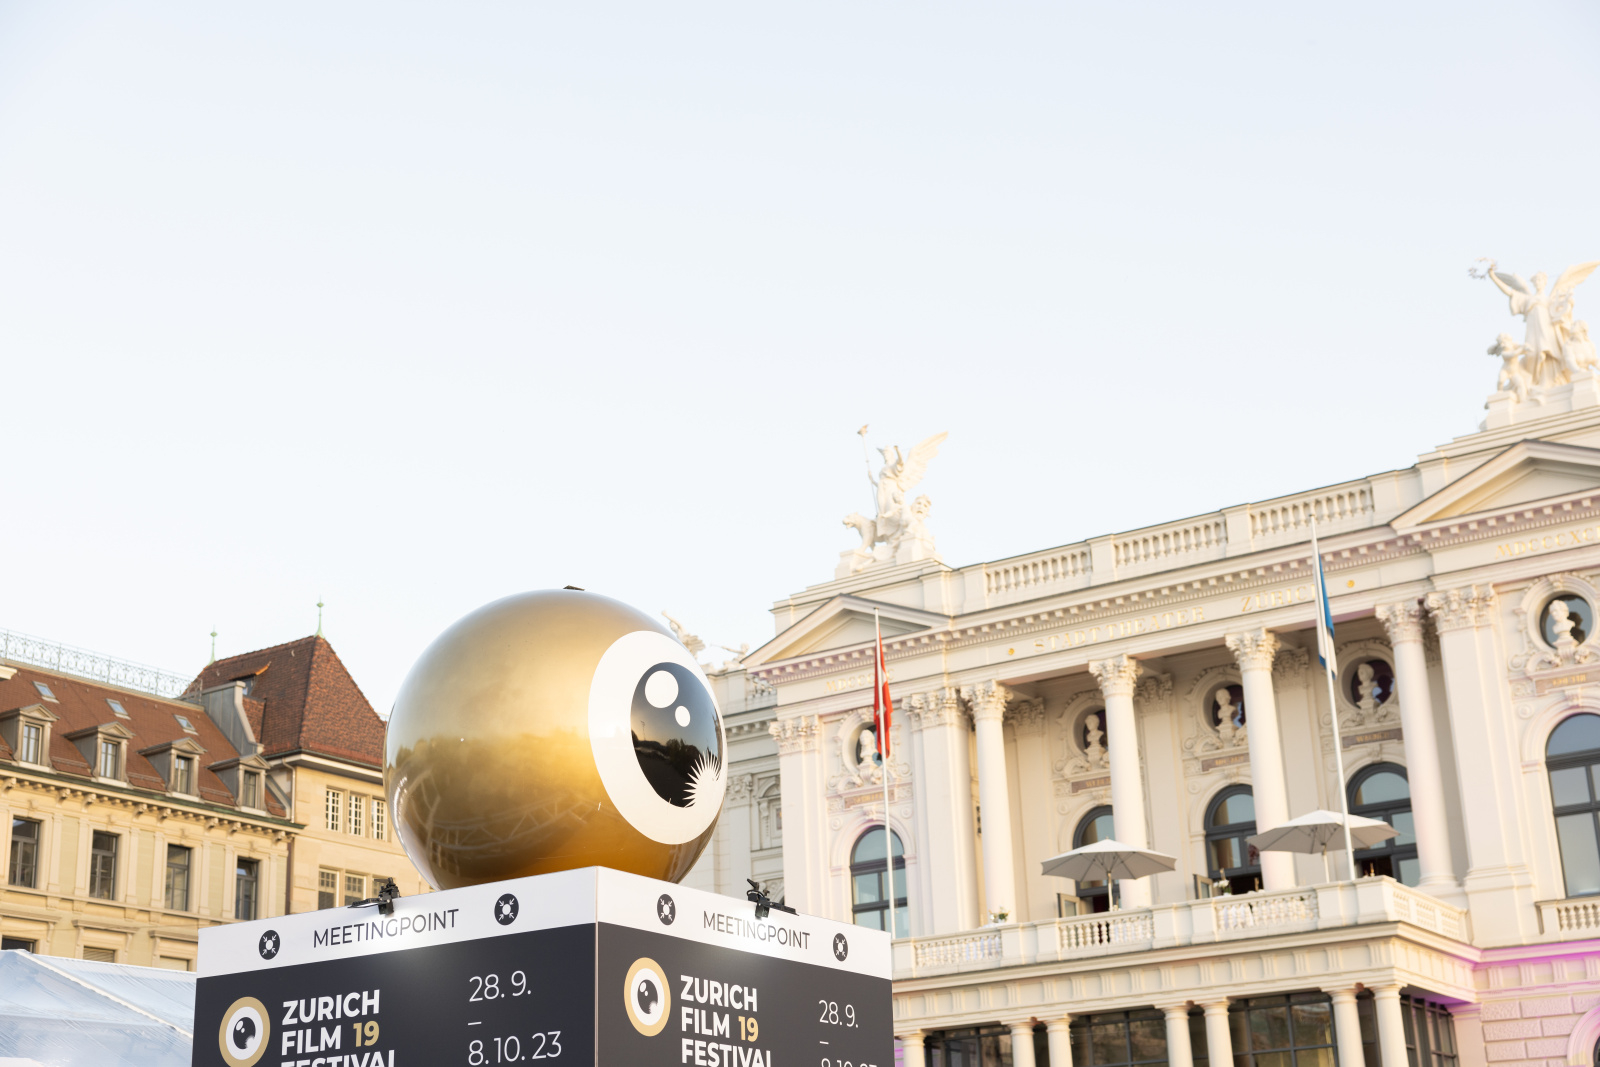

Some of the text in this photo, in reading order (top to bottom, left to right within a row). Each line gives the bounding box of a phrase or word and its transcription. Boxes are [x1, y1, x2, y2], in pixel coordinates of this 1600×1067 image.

[823, 668, 895, 694] MDCCCC
[313, 908, 460, 949] MEETINGPOINT
[703, 910, 811, 950] MEETINGPOINT
[281, 989, 380, 1026] ZURICH
[680, 974, 758, 1012] ZURICH
[281, 1020, 380, 1056] FILM 19
[681, 1006, 759, 1043] FILM 19
